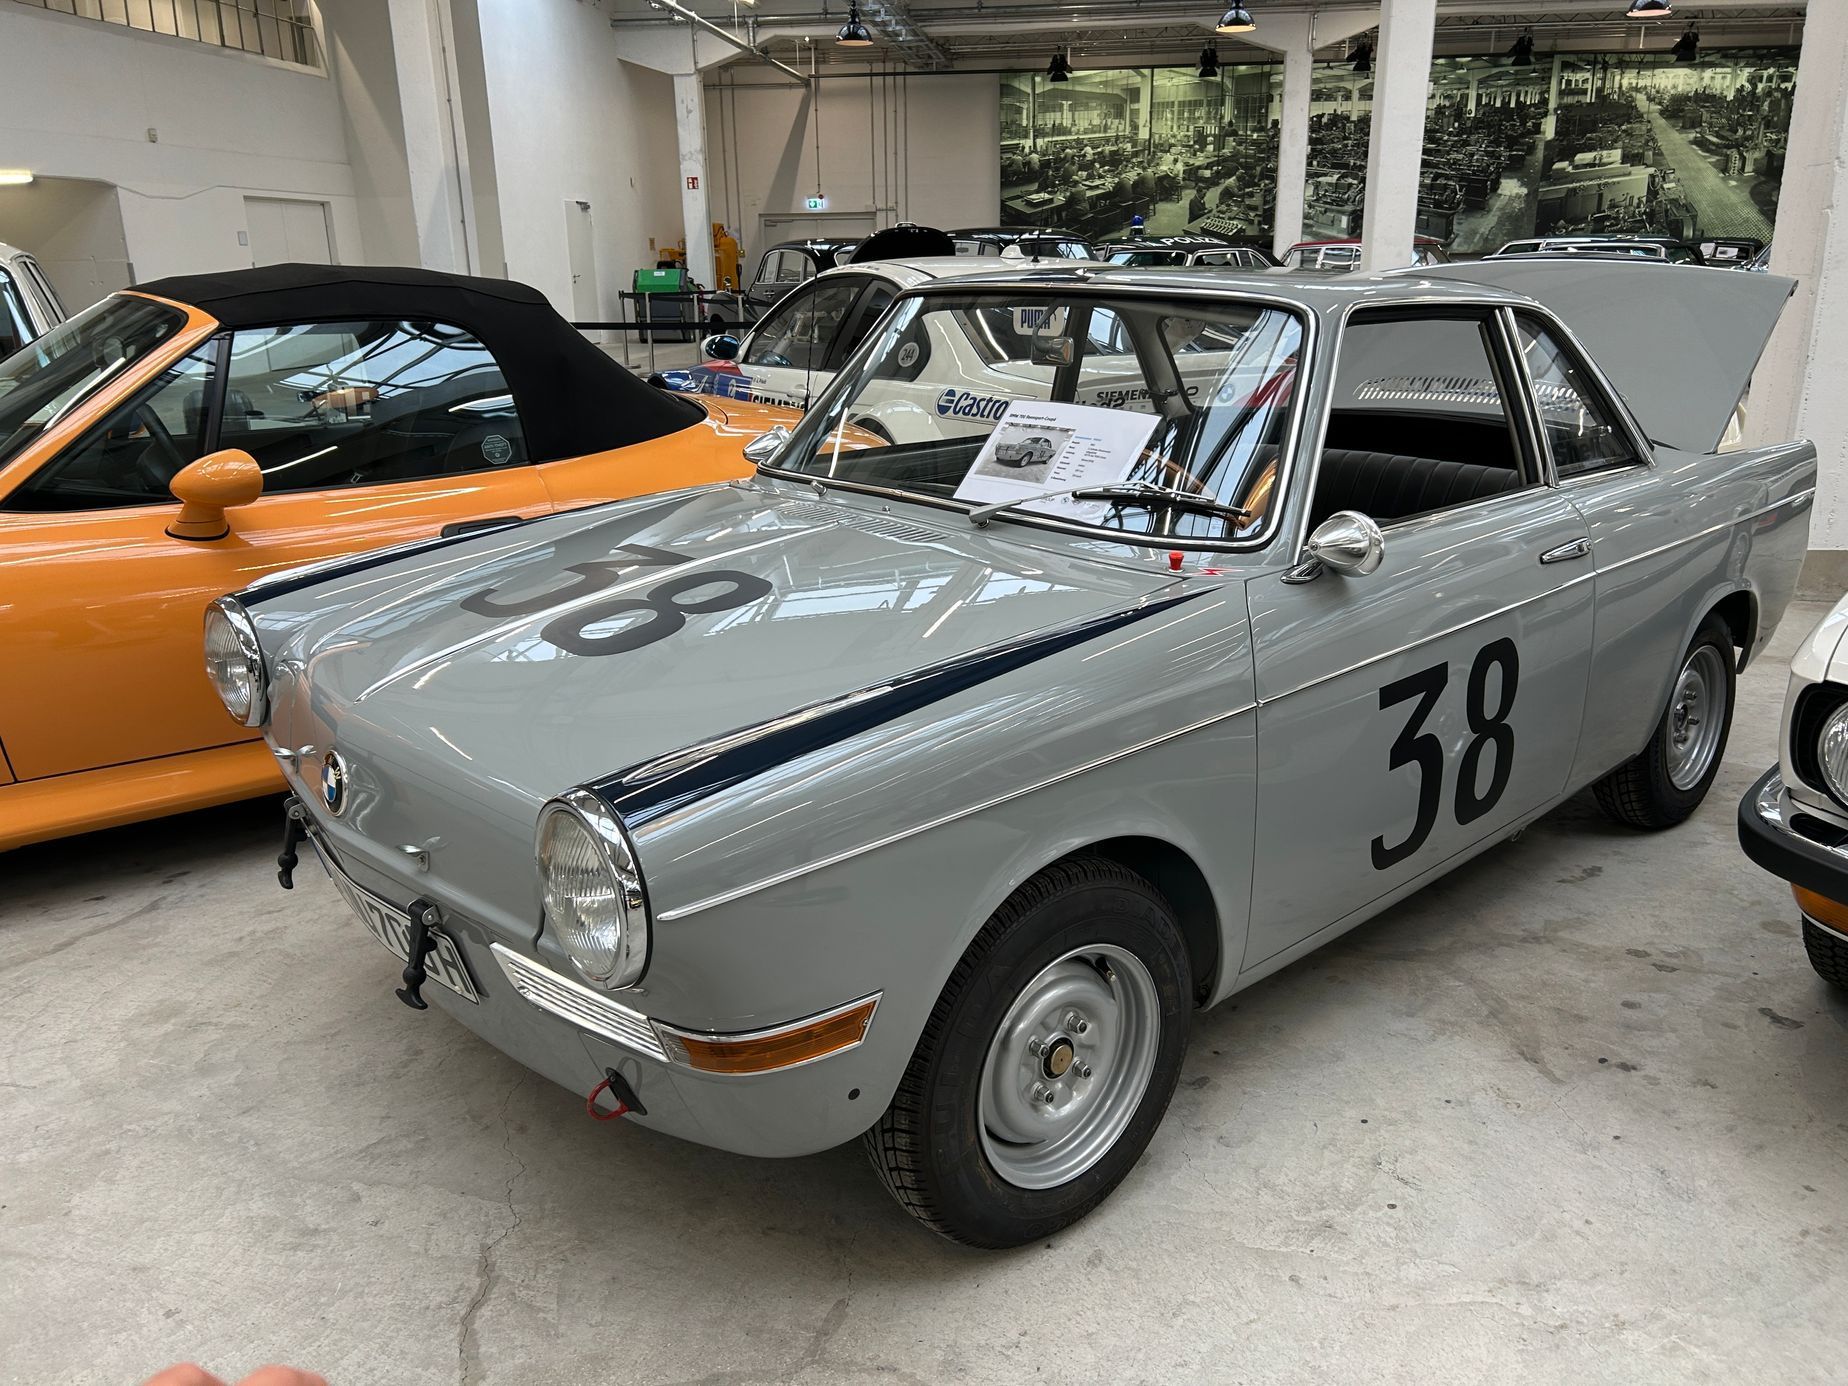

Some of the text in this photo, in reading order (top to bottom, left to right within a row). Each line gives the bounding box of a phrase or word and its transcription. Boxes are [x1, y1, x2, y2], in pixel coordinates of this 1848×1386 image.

[1020, 308, 1050, 330] PUMA
[901, 348, 915, 361] 244
[952, 391, 1010, 421] Castro
[1096, 388, 1151, 402] SIEMEN
[460, 543, 774, 657] 38
[1371, 637, 1520, 871] 38
